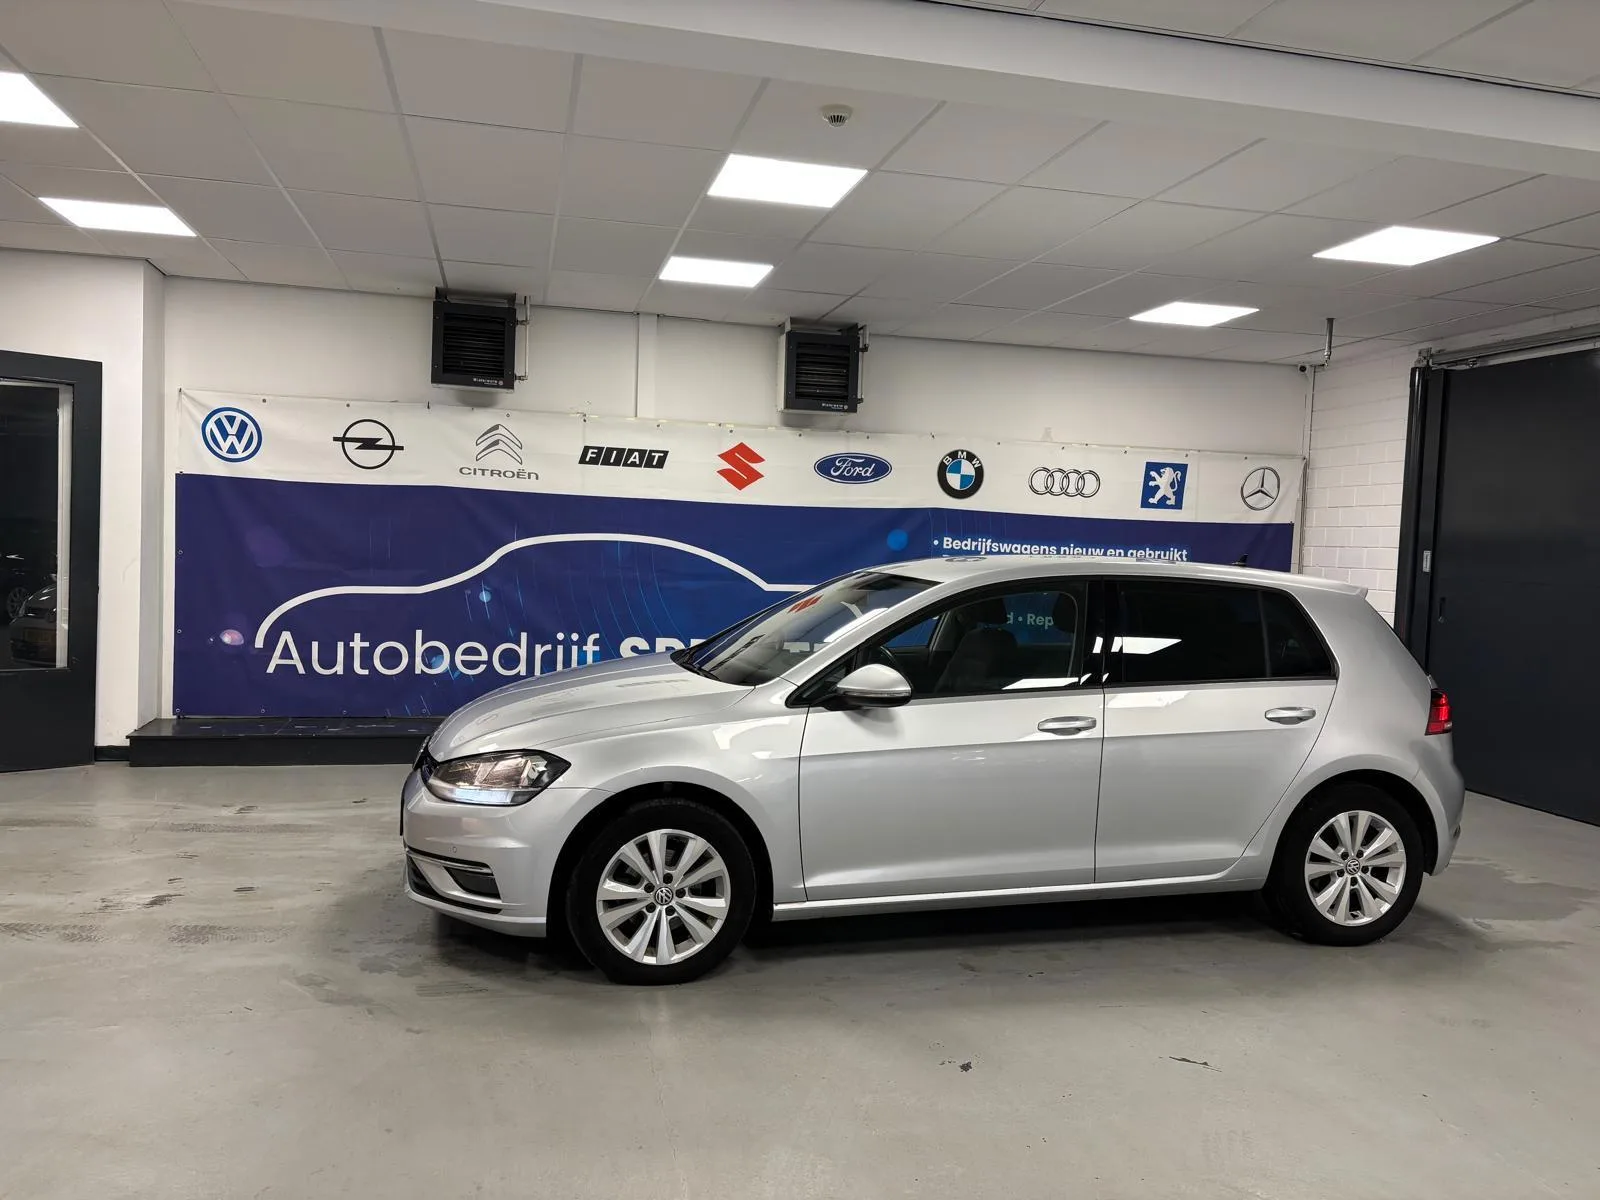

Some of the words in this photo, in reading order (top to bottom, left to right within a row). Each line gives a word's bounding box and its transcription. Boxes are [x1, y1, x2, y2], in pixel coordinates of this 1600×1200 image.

[583, 447, 666, 467] FIAT
[830, 457, 876, 477] Ford
[943, 451, 981, 468] BMW
[1060, 543, 1104, 556] nieuw
[1106, 548, 1124, 557] en
[266, 629, 600, 677] Autobedrijf
